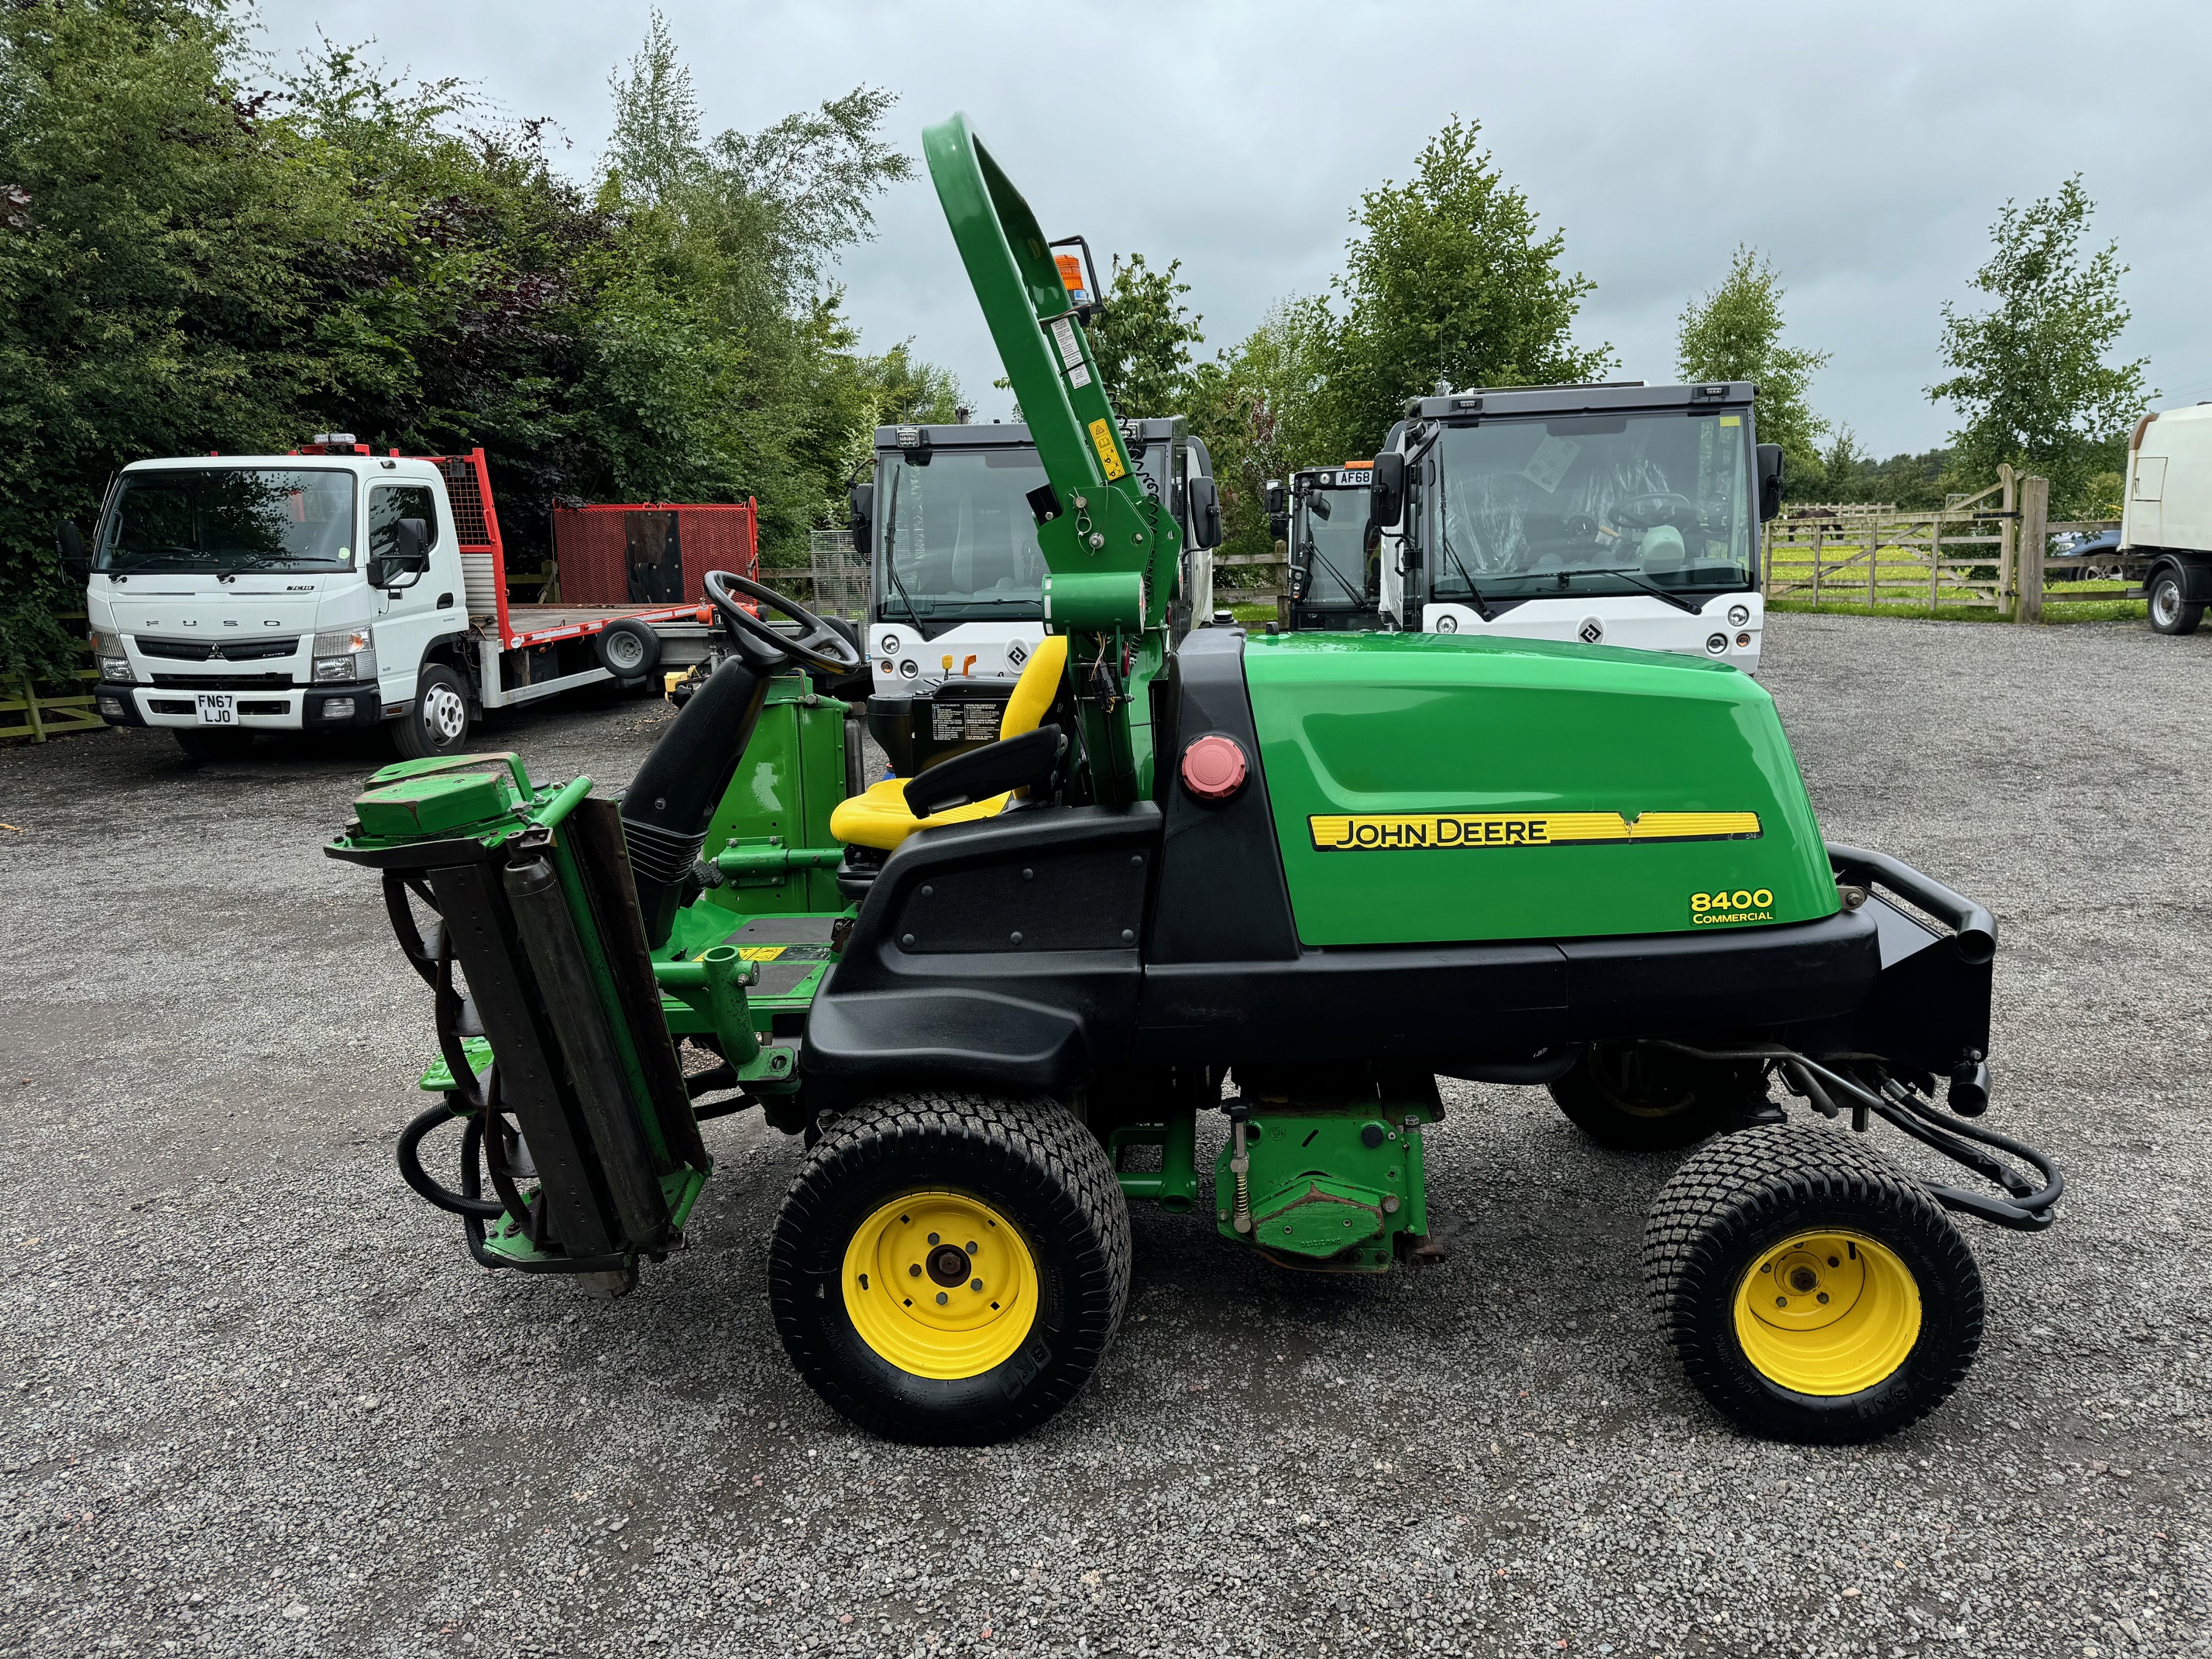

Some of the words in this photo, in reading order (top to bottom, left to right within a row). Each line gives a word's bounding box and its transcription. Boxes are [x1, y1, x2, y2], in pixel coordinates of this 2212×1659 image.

[1341, 472, 1369, 483] AF68
[198, 695, 232, 708] FN67
[204, 709, 231, 723] LJO
[1336, 820, 1429, 845] JOHN
[1437, 819, 1547, 843] DEERE
[1691, 888, 1774, 912] 8400
[1693, 912, 1774, 924] COMMERCIAL
